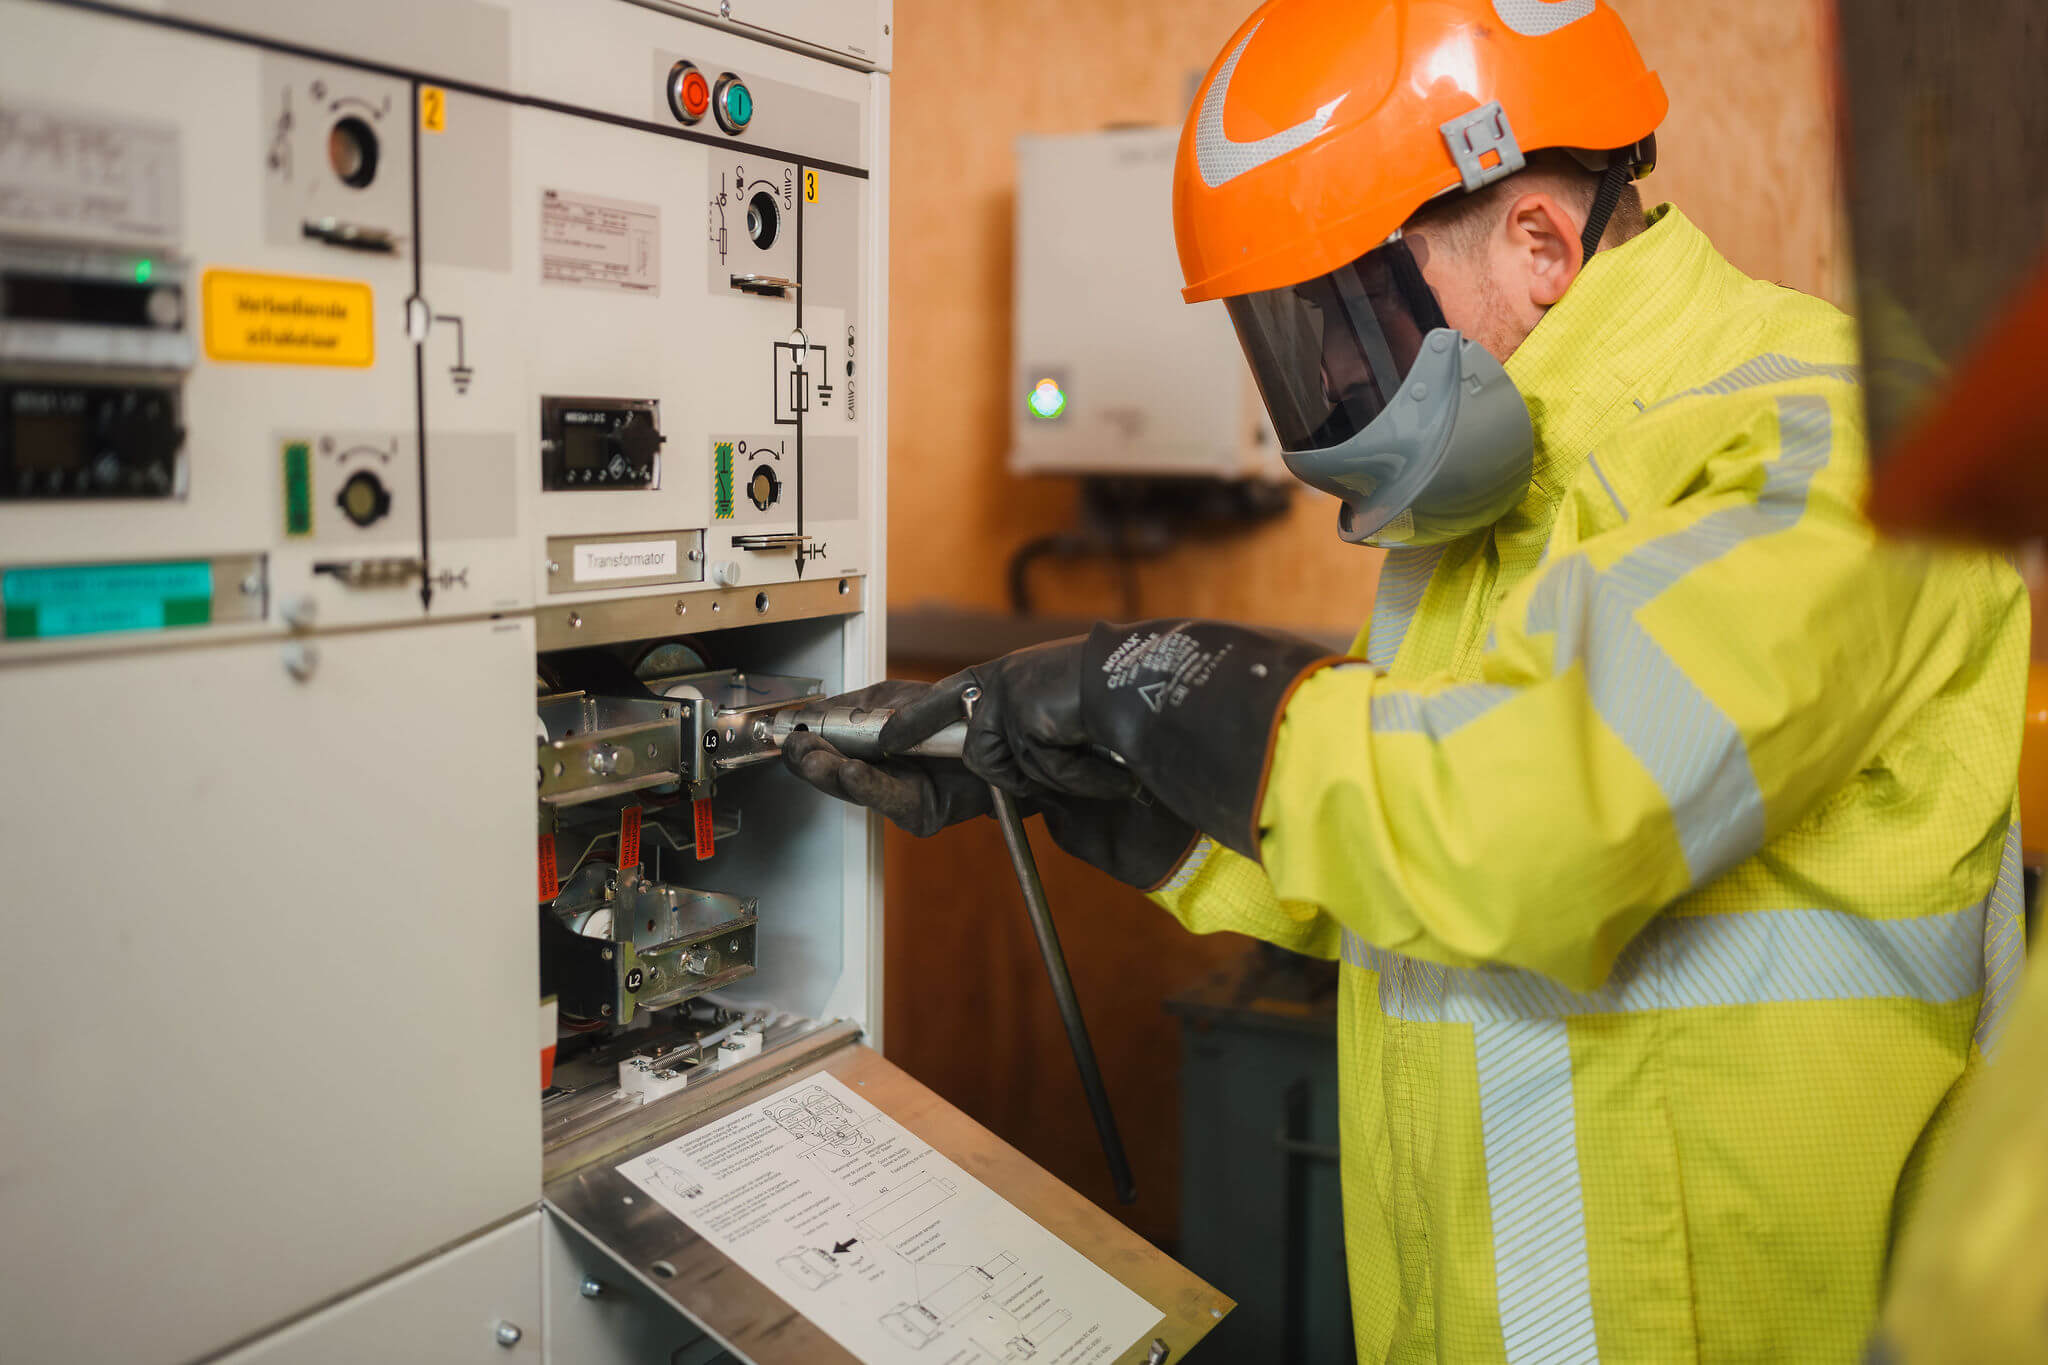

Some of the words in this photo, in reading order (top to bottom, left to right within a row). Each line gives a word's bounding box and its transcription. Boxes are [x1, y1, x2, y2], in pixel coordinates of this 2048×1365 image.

[426, 91, 439, 127] 2
[806, 173, 815, 201] 3
[587, 551, 666, 570] Transformator
[706, 735, 717, 747] L3
[629, 974, 641, 987] L2
